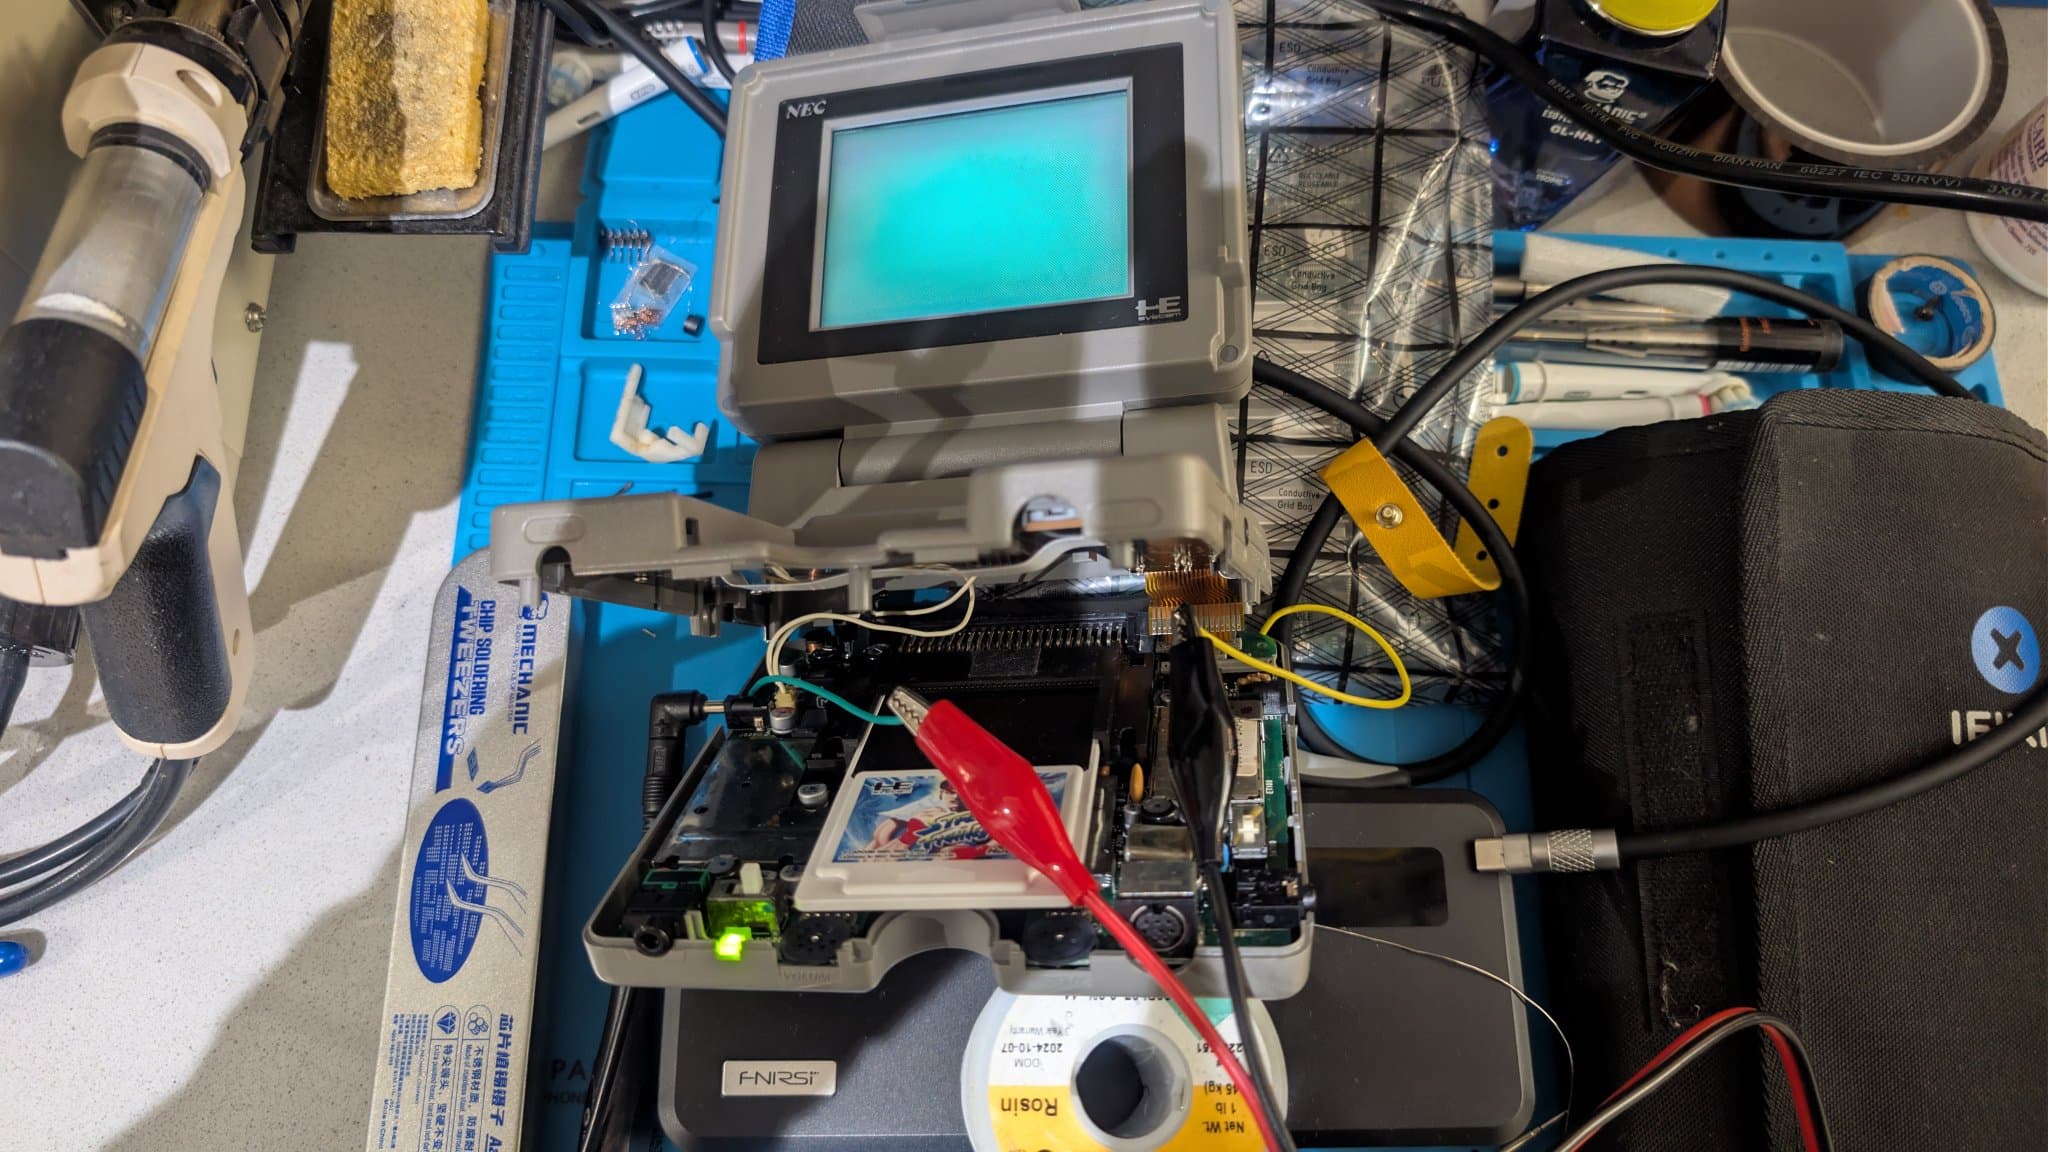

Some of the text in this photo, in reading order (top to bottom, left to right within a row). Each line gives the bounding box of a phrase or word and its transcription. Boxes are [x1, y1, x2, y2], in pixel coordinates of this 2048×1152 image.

[786, 100, 827, 119] NEC
[1800, 165, 1847, 177] 60227
[1853, 169, 1882, 180] IEC
[1891, 172, 1961, 188] 53(RVV)
[1264, 245, 1286, 256] ESD
[1291, 270, 1335, 280] Conductive
[1250, 462, 1273, 474] ESD
[1278, 487, 1320, 499] Conductive
[1277, 500, 1313, 512] Grid Bag
[469, 599, 496, 716] CHIP SOLDERING
[447, 599, 480, 756] TWEEZERS
[513, 624, 537, 734] MECHANIC
[432, 1044, 440, 1060] Extra
[1001, 1043, 1063, 1053] 2024-10-07
[1014, 1058, 1040, 1068] DOM
[1204, 1080, 1223, 1096] kg)
[1001, 1097, 1058, 1117] Rosin
[1216, 1102, 1237, 1115] 1 lb
[1202, 1121, 1245, 1134] Net Wt.
